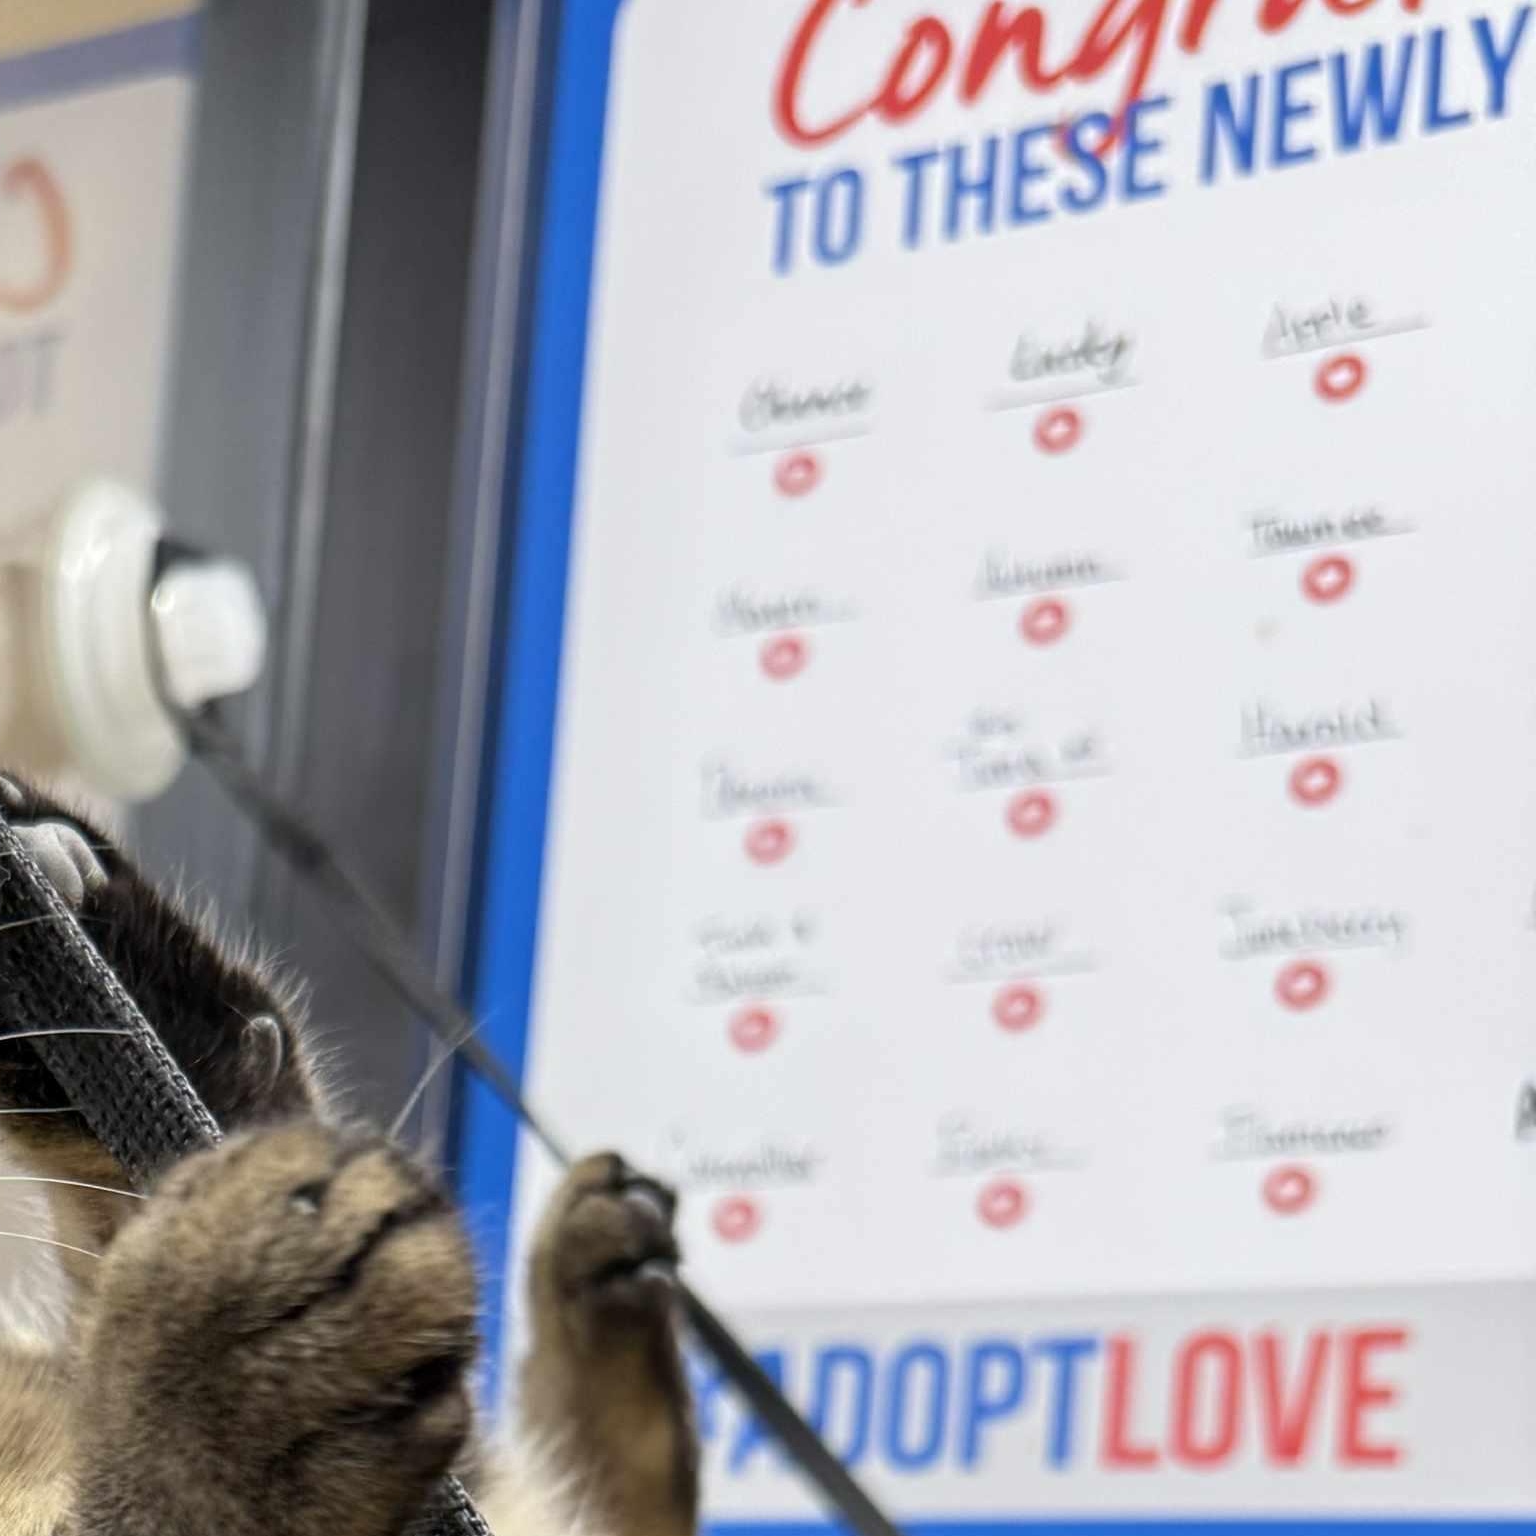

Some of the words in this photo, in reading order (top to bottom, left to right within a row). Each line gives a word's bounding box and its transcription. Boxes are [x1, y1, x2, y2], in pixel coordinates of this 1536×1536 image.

[766, 167, 866, 277] TO
[892, 95, 1174, 252] THESE
[1197, 3, 1534, 185] NEWLY
